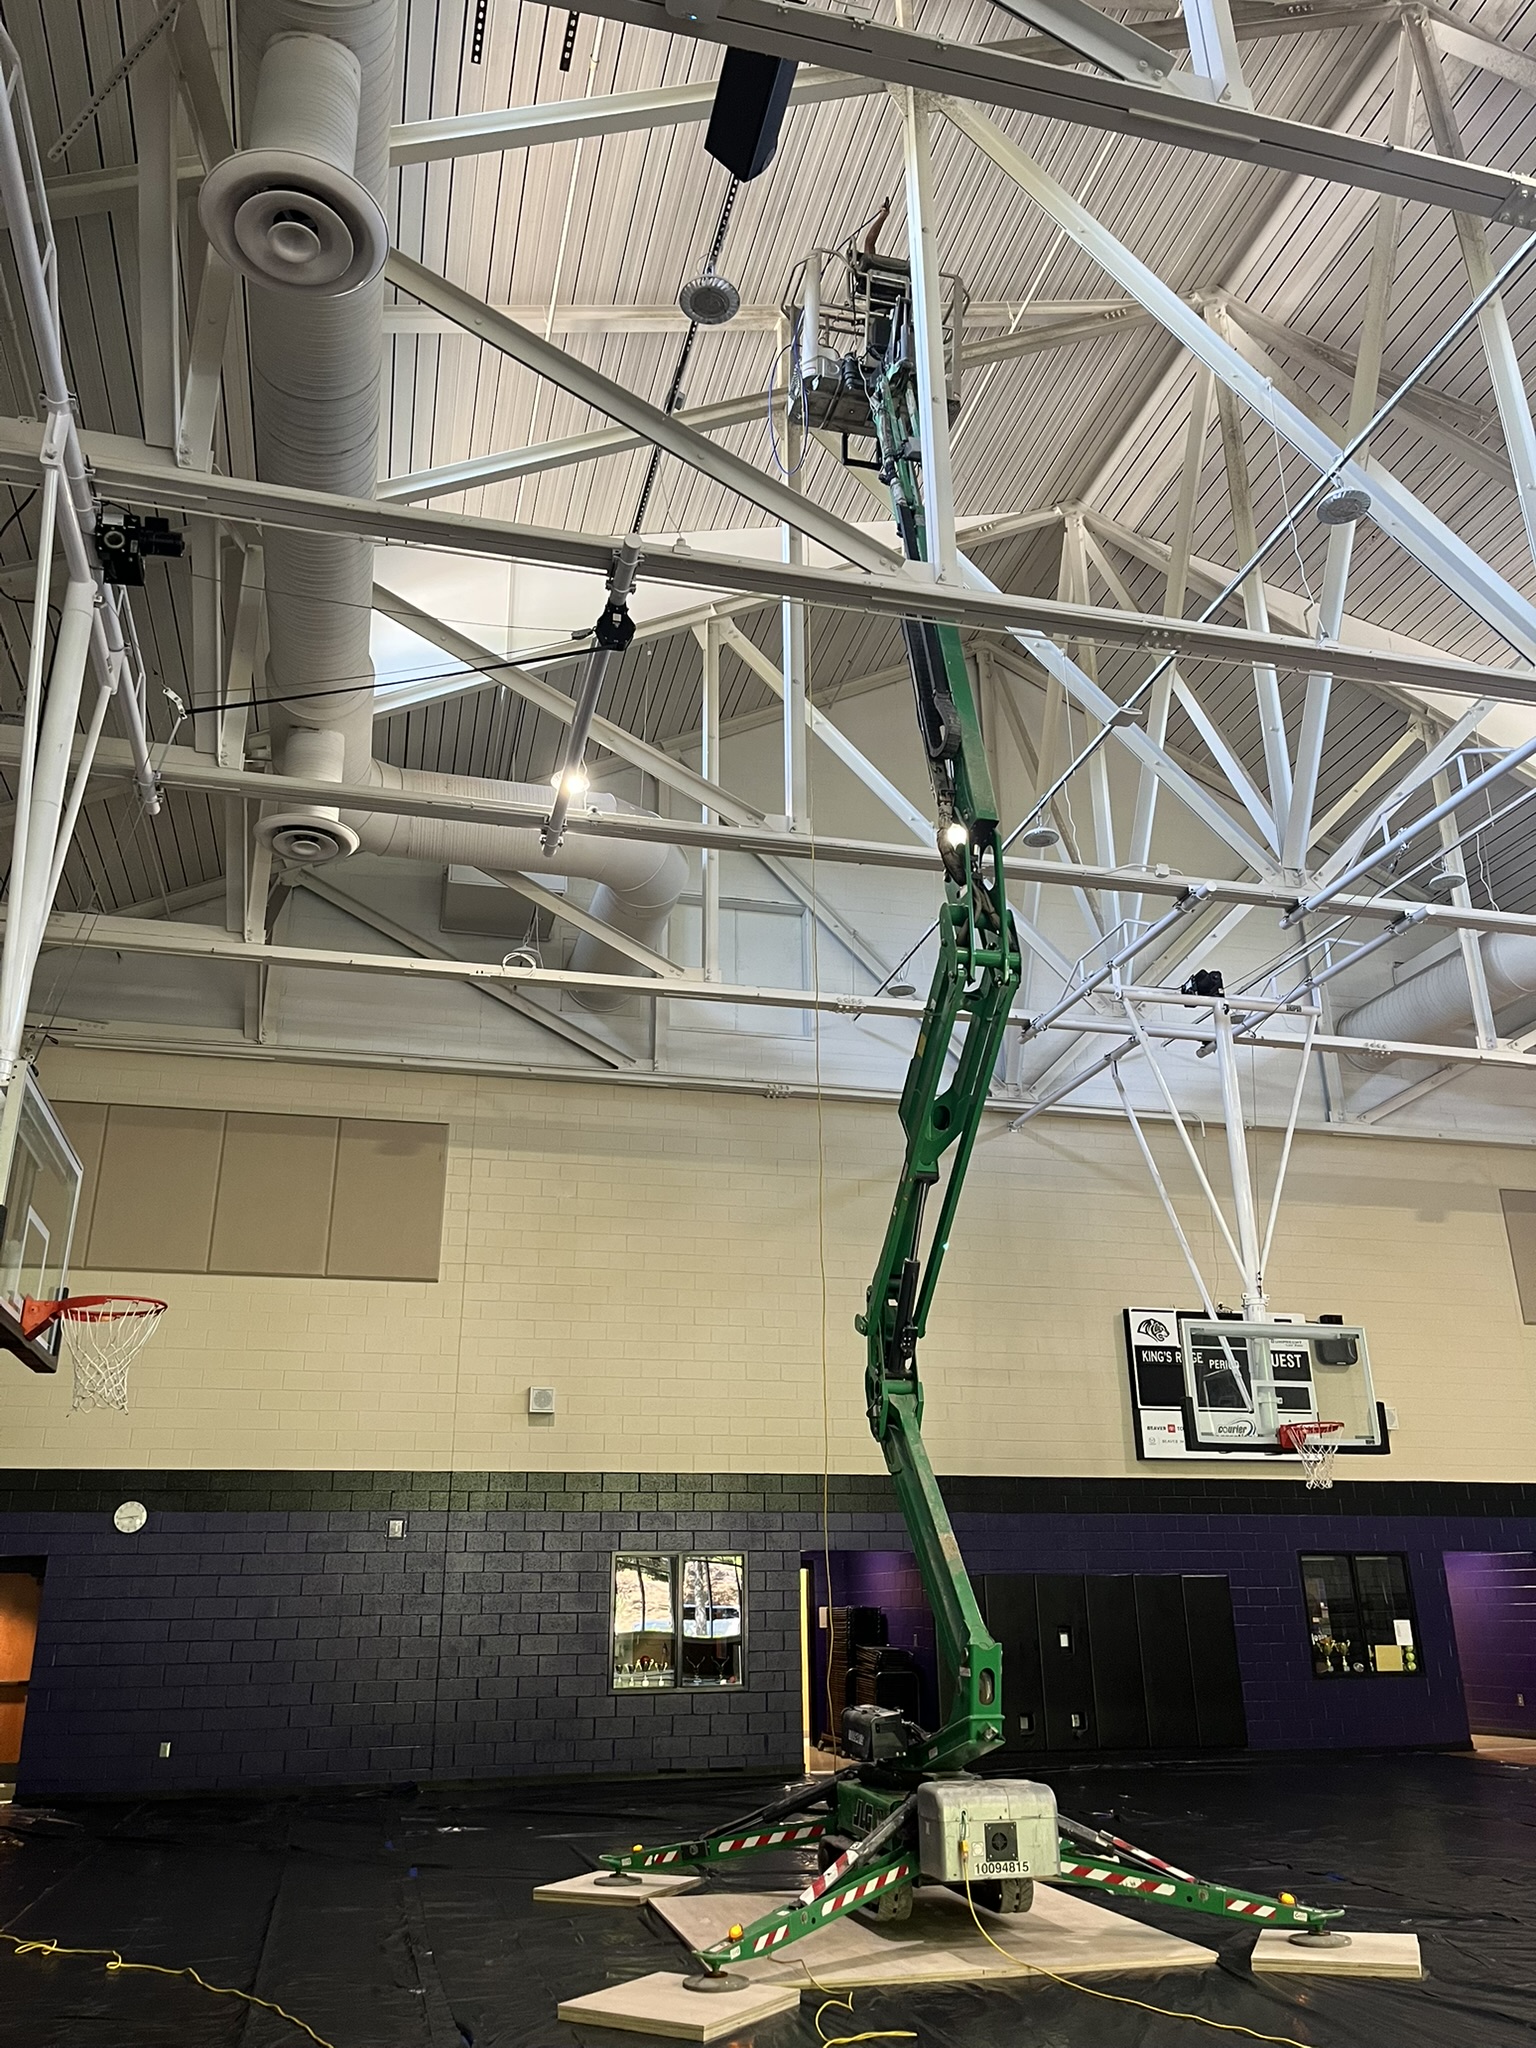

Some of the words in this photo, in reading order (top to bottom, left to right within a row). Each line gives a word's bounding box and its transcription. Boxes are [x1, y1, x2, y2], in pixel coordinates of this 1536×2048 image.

[1141, 1350, 1173, 1363] KING'S
[1175, 1352, 1204, 1364] RGE
[1270, 1354, 1302, 1368] UEST
[975, 1861, 1029, 1874] 10094815
